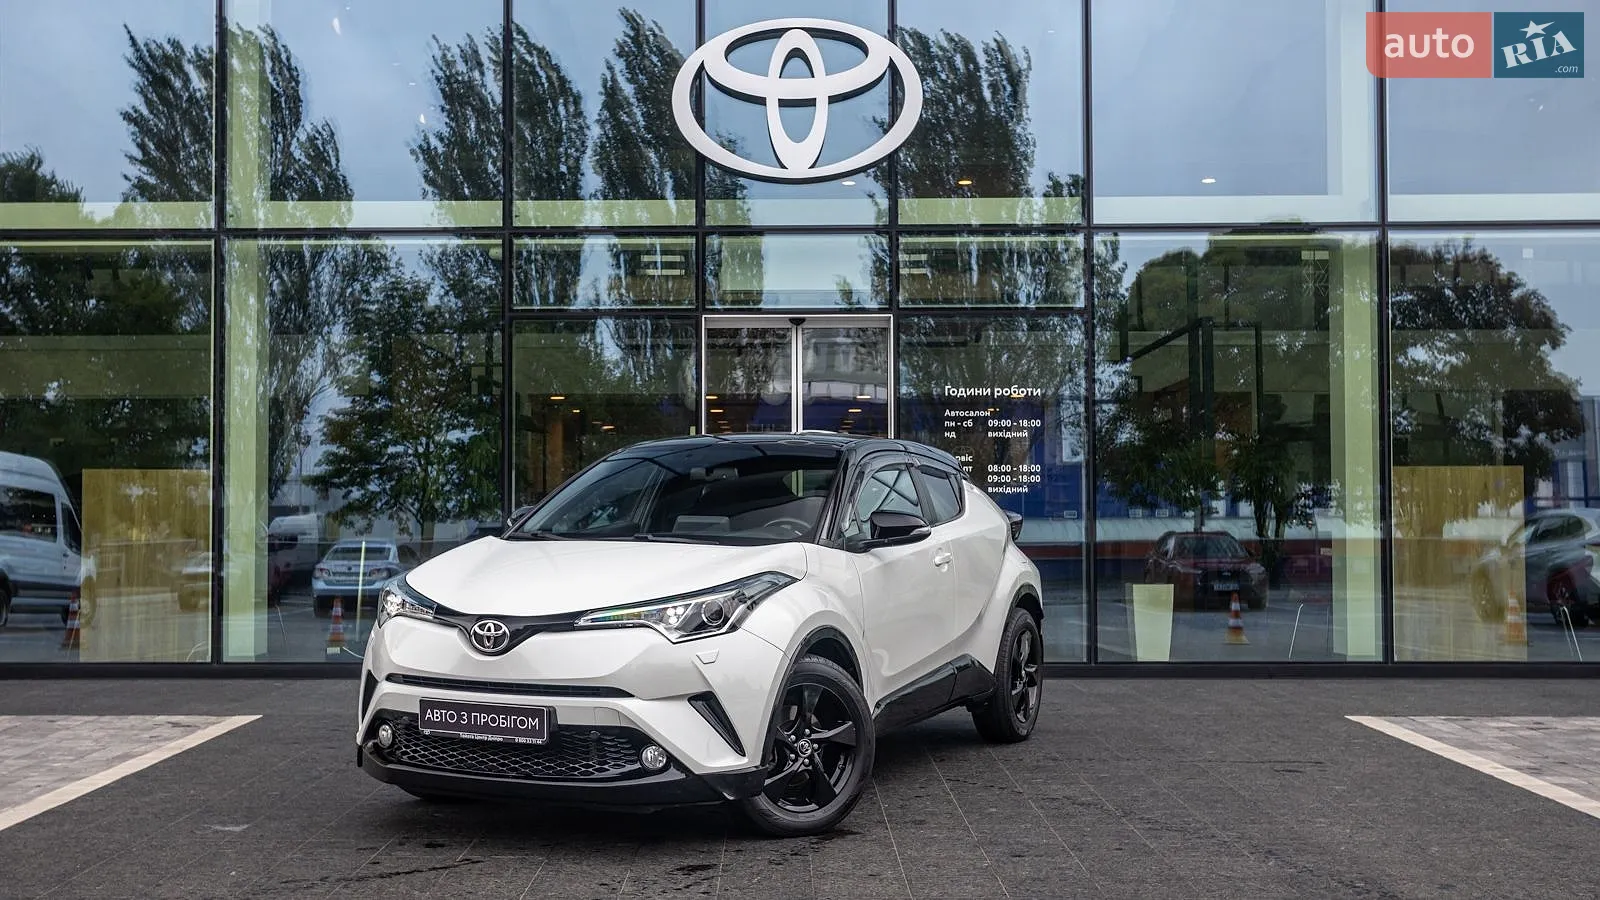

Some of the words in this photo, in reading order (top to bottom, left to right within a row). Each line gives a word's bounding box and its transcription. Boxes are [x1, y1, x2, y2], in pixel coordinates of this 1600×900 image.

[944, 385, 991, 398] Години
[994, 384, 1041, 398] роботи
[944, 408, 991, 417] Автосалон
[962, 419, 973, 427] сб
[988, 419, 1011, 427] 09:00
[1019, 419, 1041, 427] 18:00
[944, 431, 956, 439] нд
[988, 429, 1028, 439] вихідний
[987, 464, 1011, 472] 08:00
[1019, 464, 1041, 472] 18:00
[987, 475, 1011, 483] 09:00
[1019, 475, 1041, 483] 18:00
[987, 485, 1028, 494] вихідний
[425, 709, 457, 723] АВТО
[471, 713, 539, 730] ПРОБІГОМ
